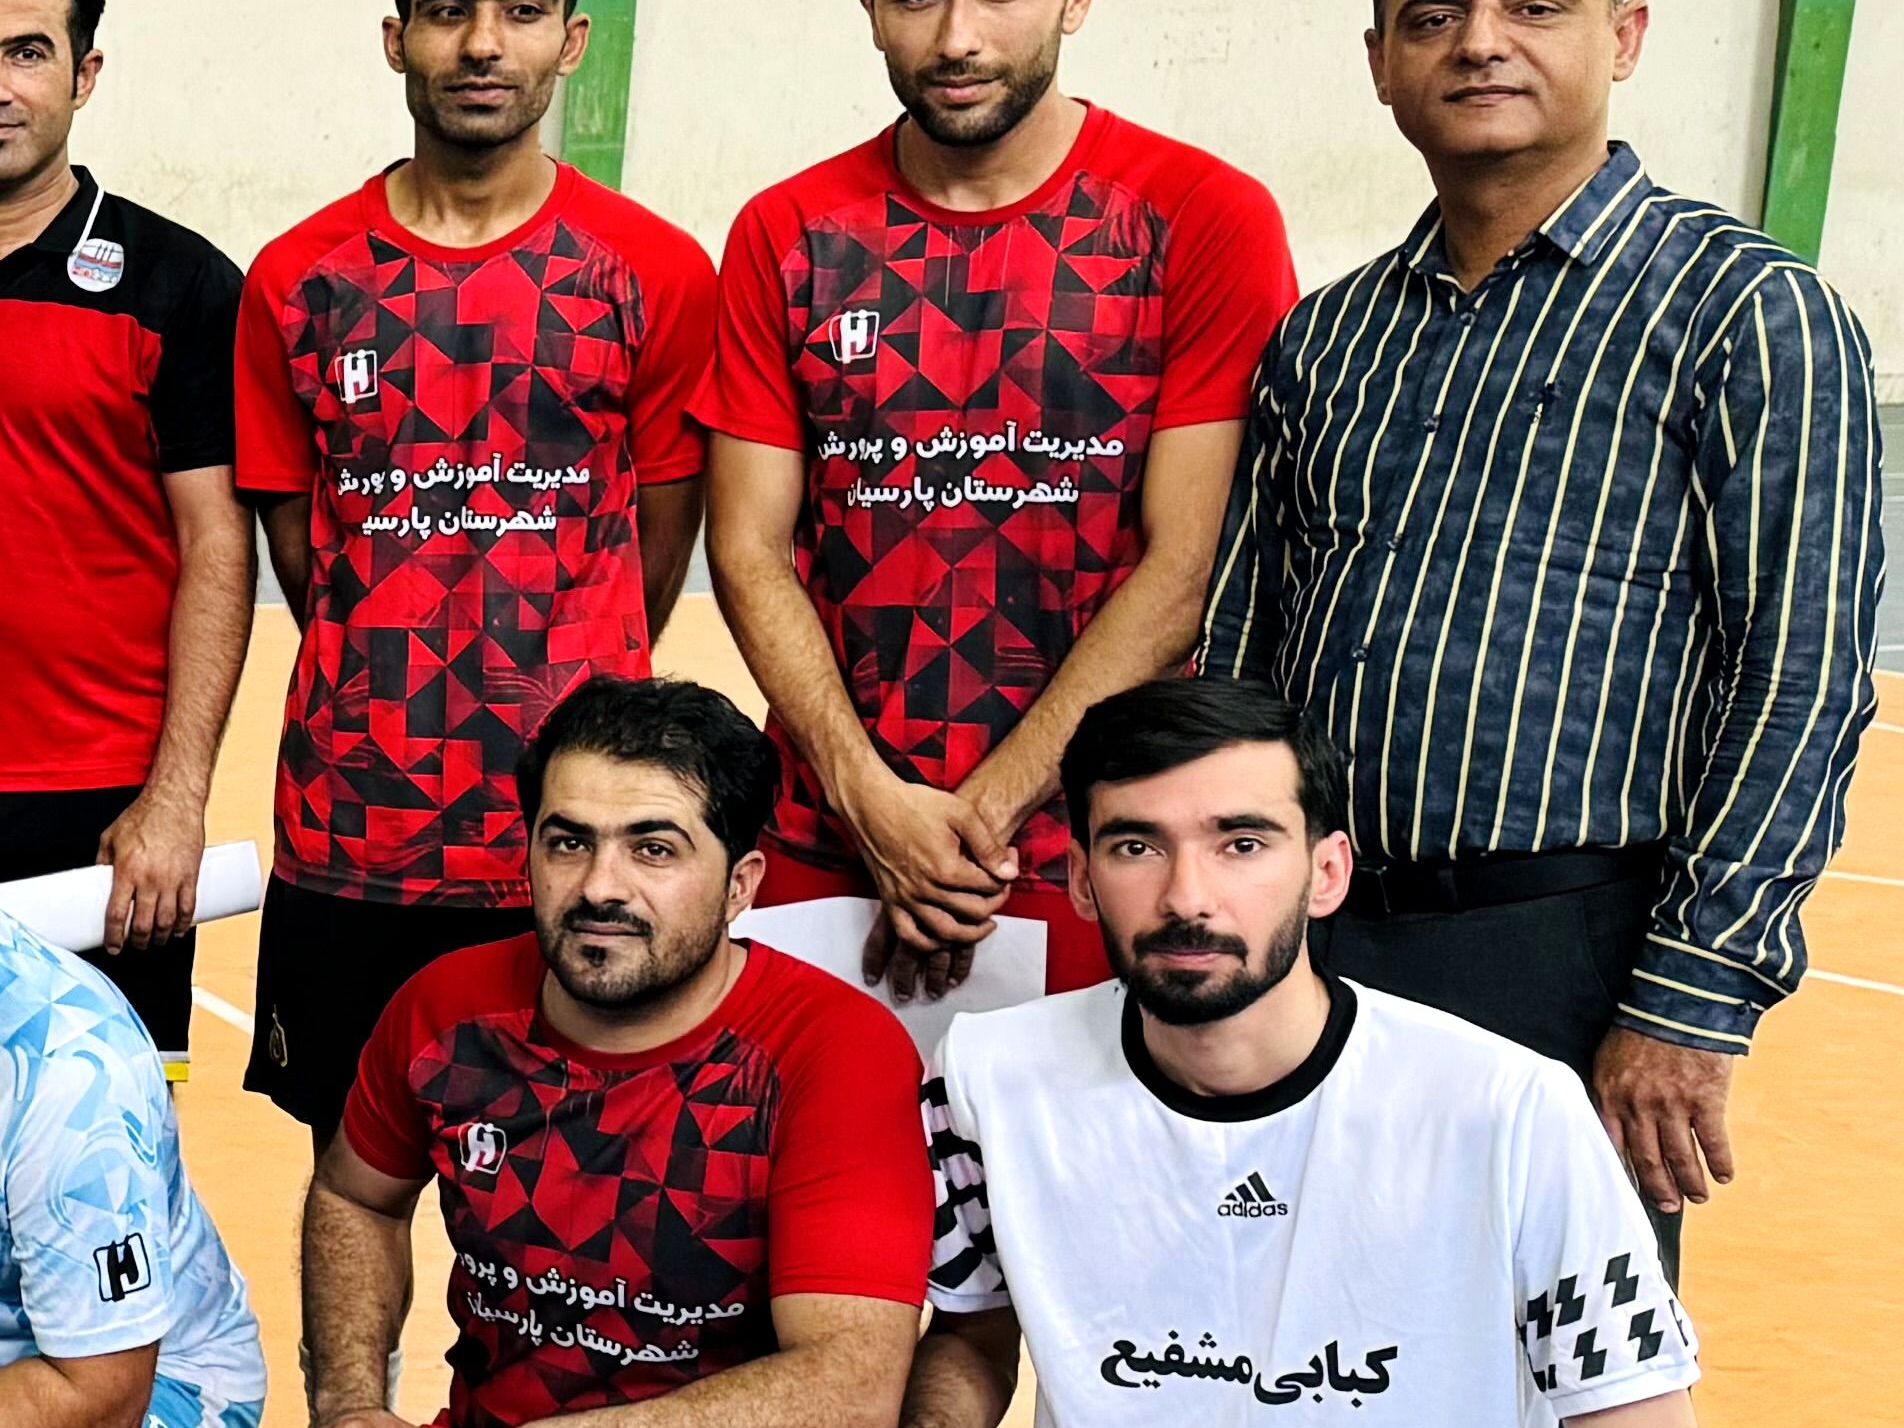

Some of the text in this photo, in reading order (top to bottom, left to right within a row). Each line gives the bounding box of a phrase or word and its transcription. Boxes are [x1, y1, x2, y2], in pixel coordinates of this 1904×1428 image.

[817, 420, 1125, 464] مدیریت آموزش و پرورش
[389, 466, 407, 492] و
[413, 452, 501, 490] آموزش
[506, 462, 591, 491] مدیریت
[941, 476, 1079, 509] شهرستان
[361, 504, 557, 540] شهرستان پارسی
[1217, 1200, 1289, 1219] adidas
[502, 1265, 519, 1289] و
[525, 1267, 627, 1310] آموزش
[634, 1292, 745, 1325] مدیریت
[550, 1323, 700, 1366] شهرستان
[1100, 1328, 1399, 1409] کبابی مشفیع
